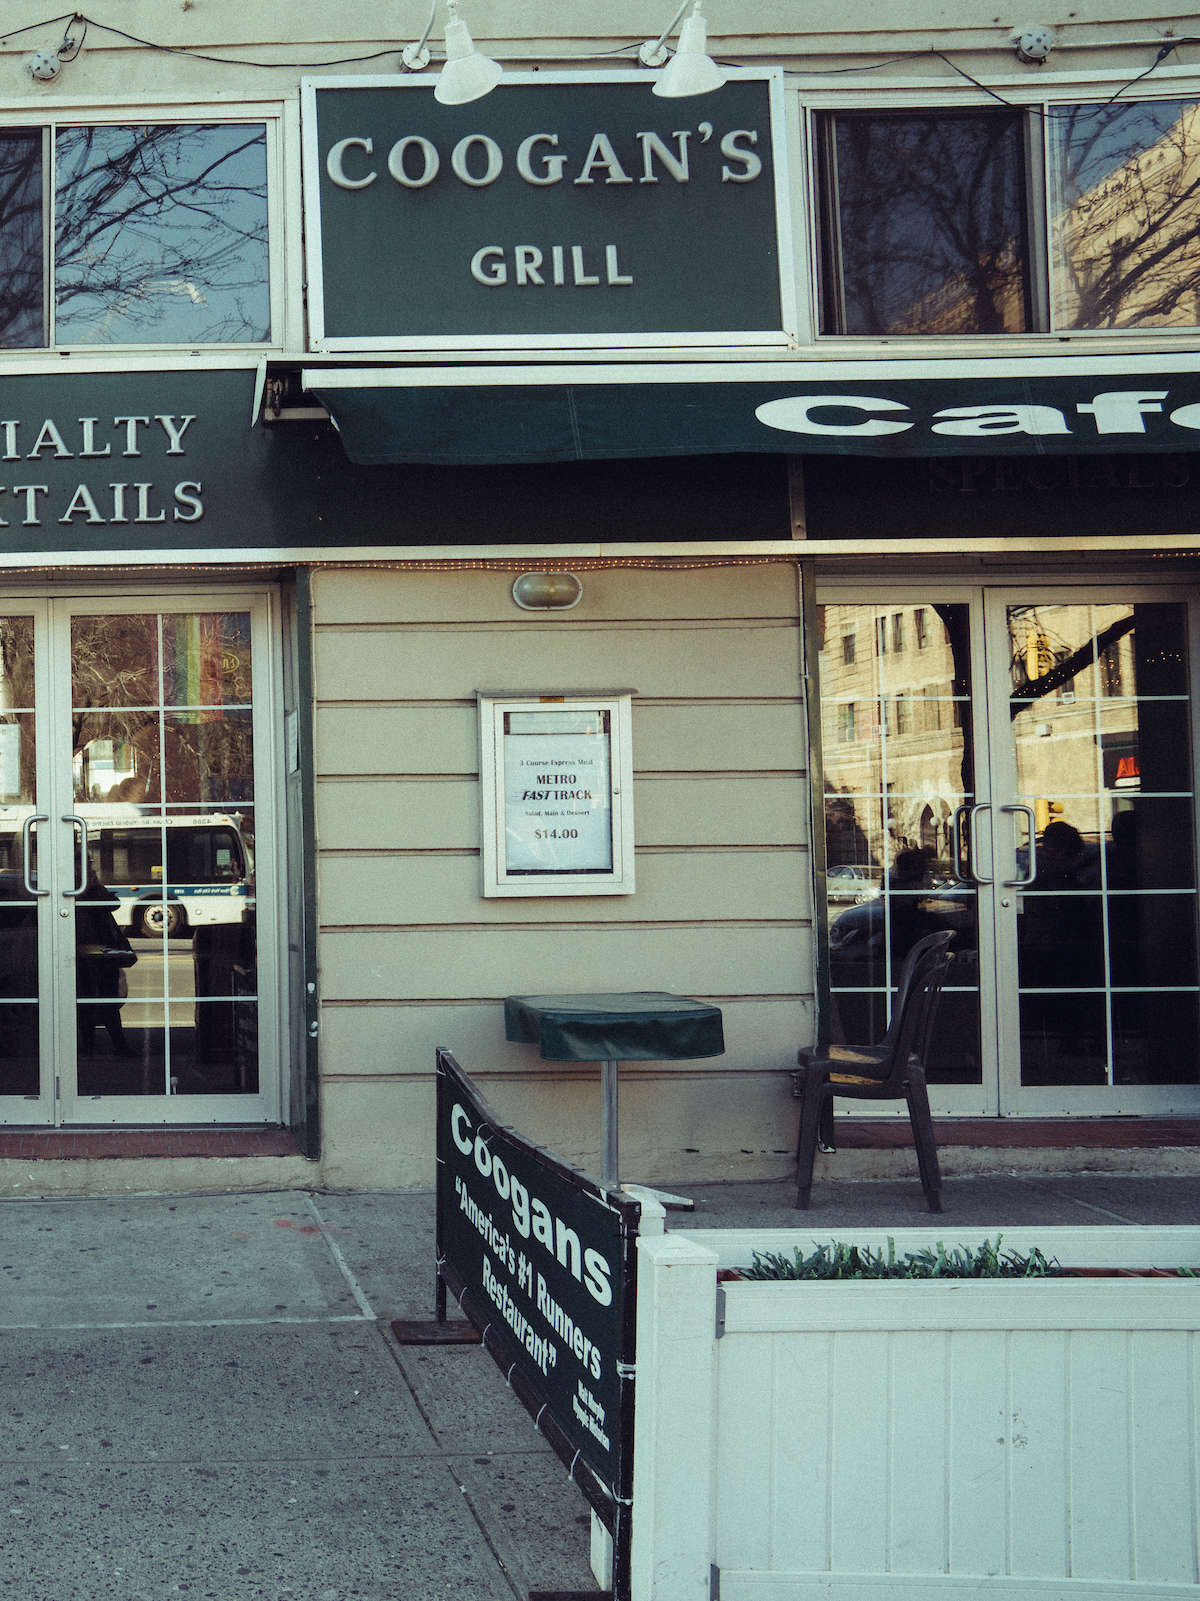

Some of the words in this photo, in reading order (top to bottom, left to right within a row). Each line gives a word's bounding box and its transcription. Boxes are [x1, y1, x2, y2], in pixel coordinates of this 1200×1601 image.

[326, 121, 763, 190] COOGAN'S
[470, 244, 634, 287] GRILL
[754, 390, 1200, 437] Caf
[536, 774, 577, 785] METRO
[550, 759, 576, 767] Express
[535, 828, 579, 839] $14.00
[451, 1103, 613, 1307] Coogans
[518, 1250, 533, 1299] #1
[537, 1271, 602, 1380] Runners
